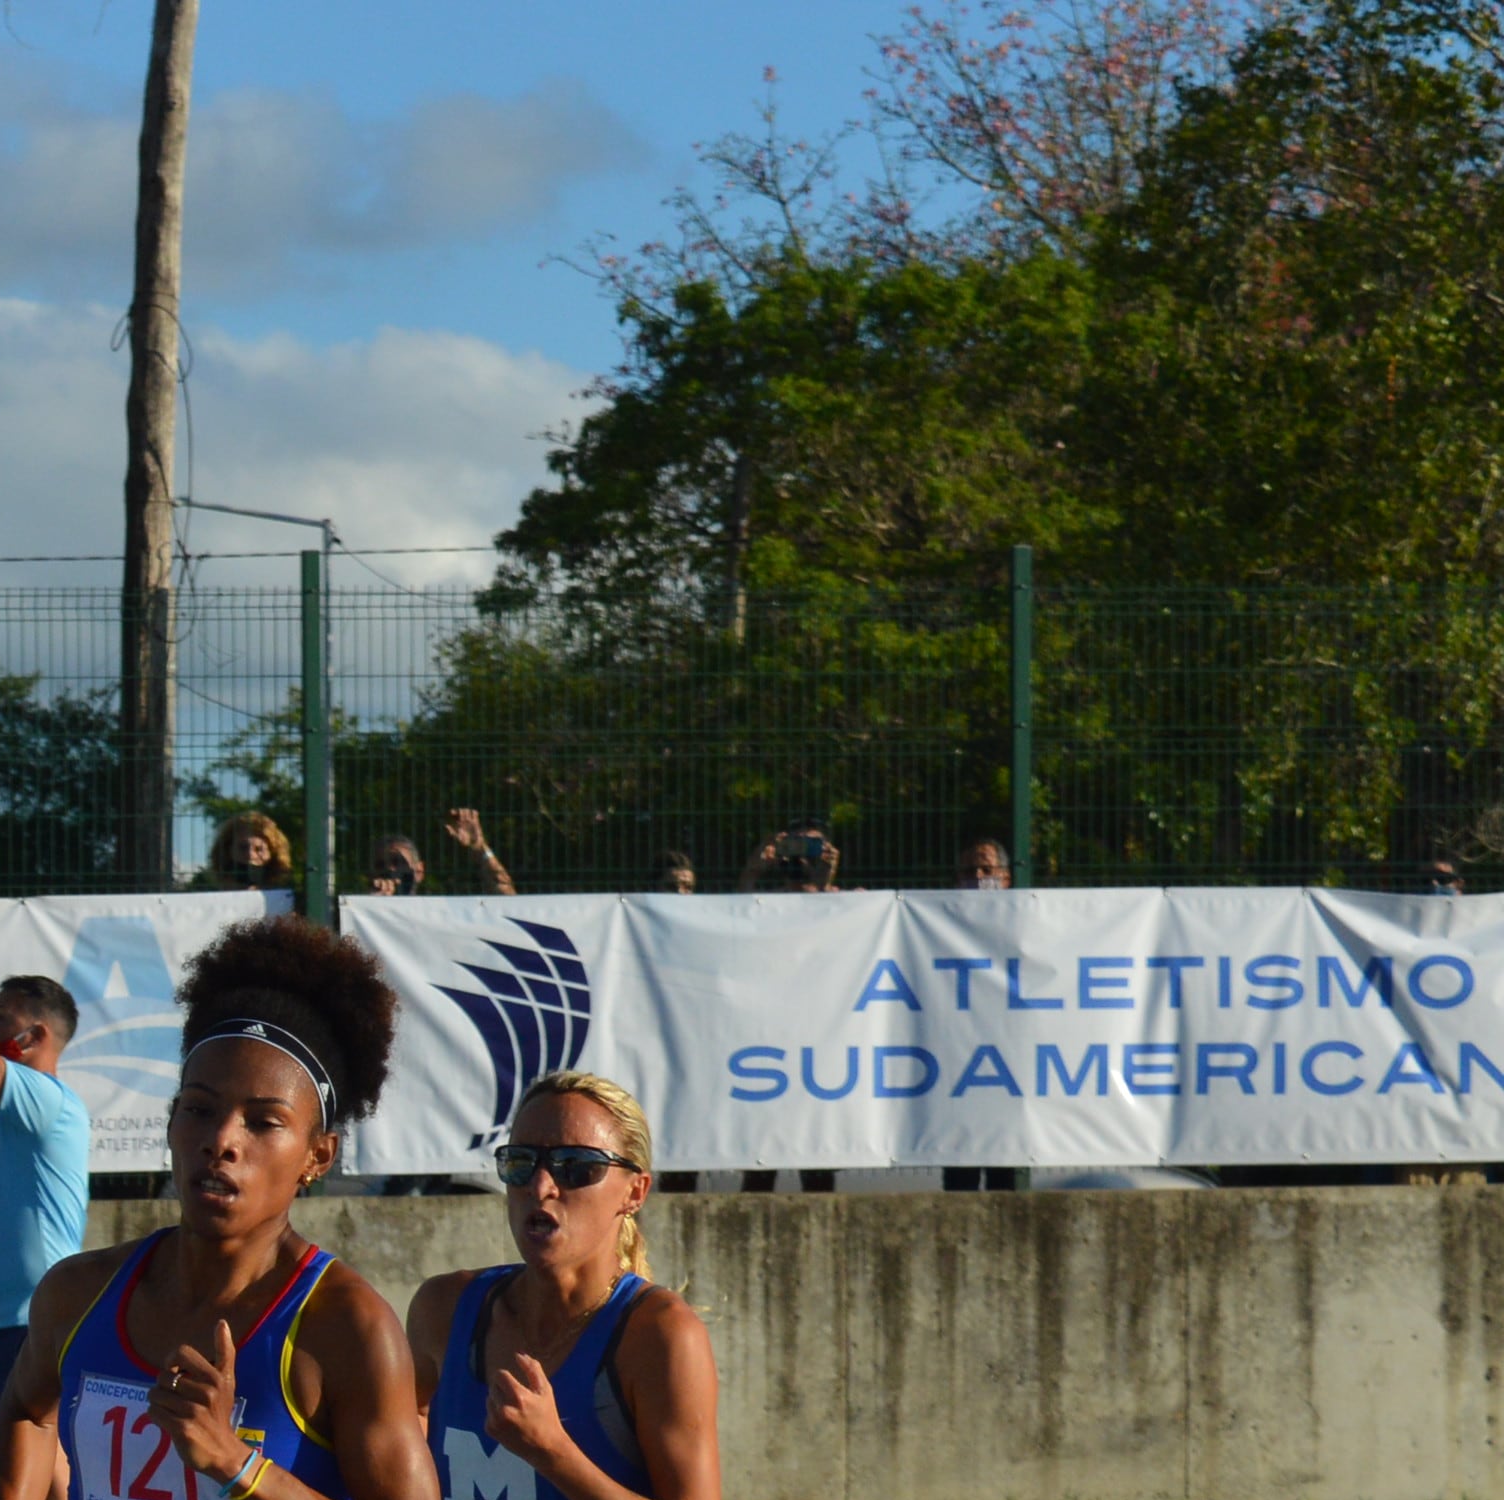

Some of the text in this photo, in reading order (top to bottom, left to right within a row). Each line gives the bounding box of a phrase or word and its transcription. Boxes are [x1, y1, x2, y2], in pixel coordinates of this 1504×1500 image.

[853, 953, 1475, 1012] ATLETISMO
[727, 1040, 1504, 1102] SUDAMERICAN
[85, 1380, 149, 1403] CONCEPCIO
